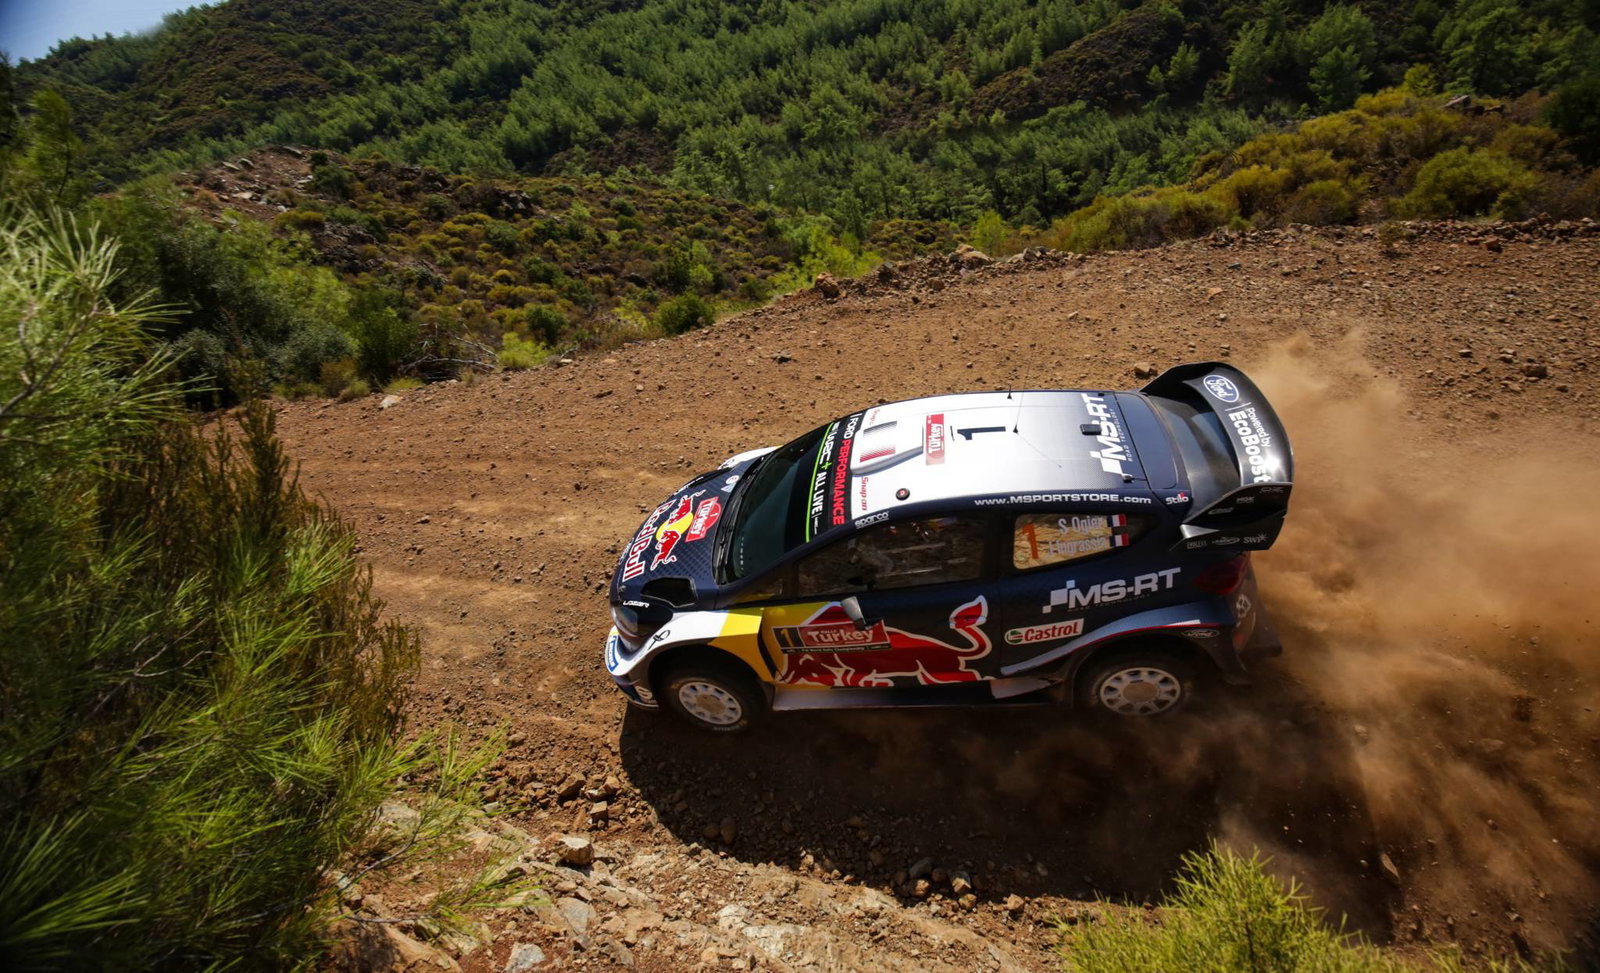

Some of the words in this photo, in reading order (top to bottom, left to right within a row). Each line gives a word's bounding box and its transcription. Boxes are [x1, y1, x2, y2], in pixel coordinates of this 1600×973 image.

[1206, 378, 1234, 399] Ford
[843, 416, 860, 440] FORD
[1245, 406, 1269, 439] Powered
[1260, 434, 1272, 448] by
[928, 422, 944, 455] Turkey
[814, 471, 827, 492] ALL
[831, 438, 852, 526] PERFORMANCE
[811, 491, 825, 515] LIVE
[974, 493, 1152, 506] www.MSPORTSTORE.com
[1166, 491, 1189, 505] Stilo
[854, 511, 889, 528] sparco
[1022, 523, 1039, 560] 1
[622, 536, 652, 582] Bull
[1068, 567, 1181, 611] MS-RT
[780, 628, 795, 648] 1
[807, 628, 874, 643] Turkey
[1024, 621, 1079, 642] Castrol
